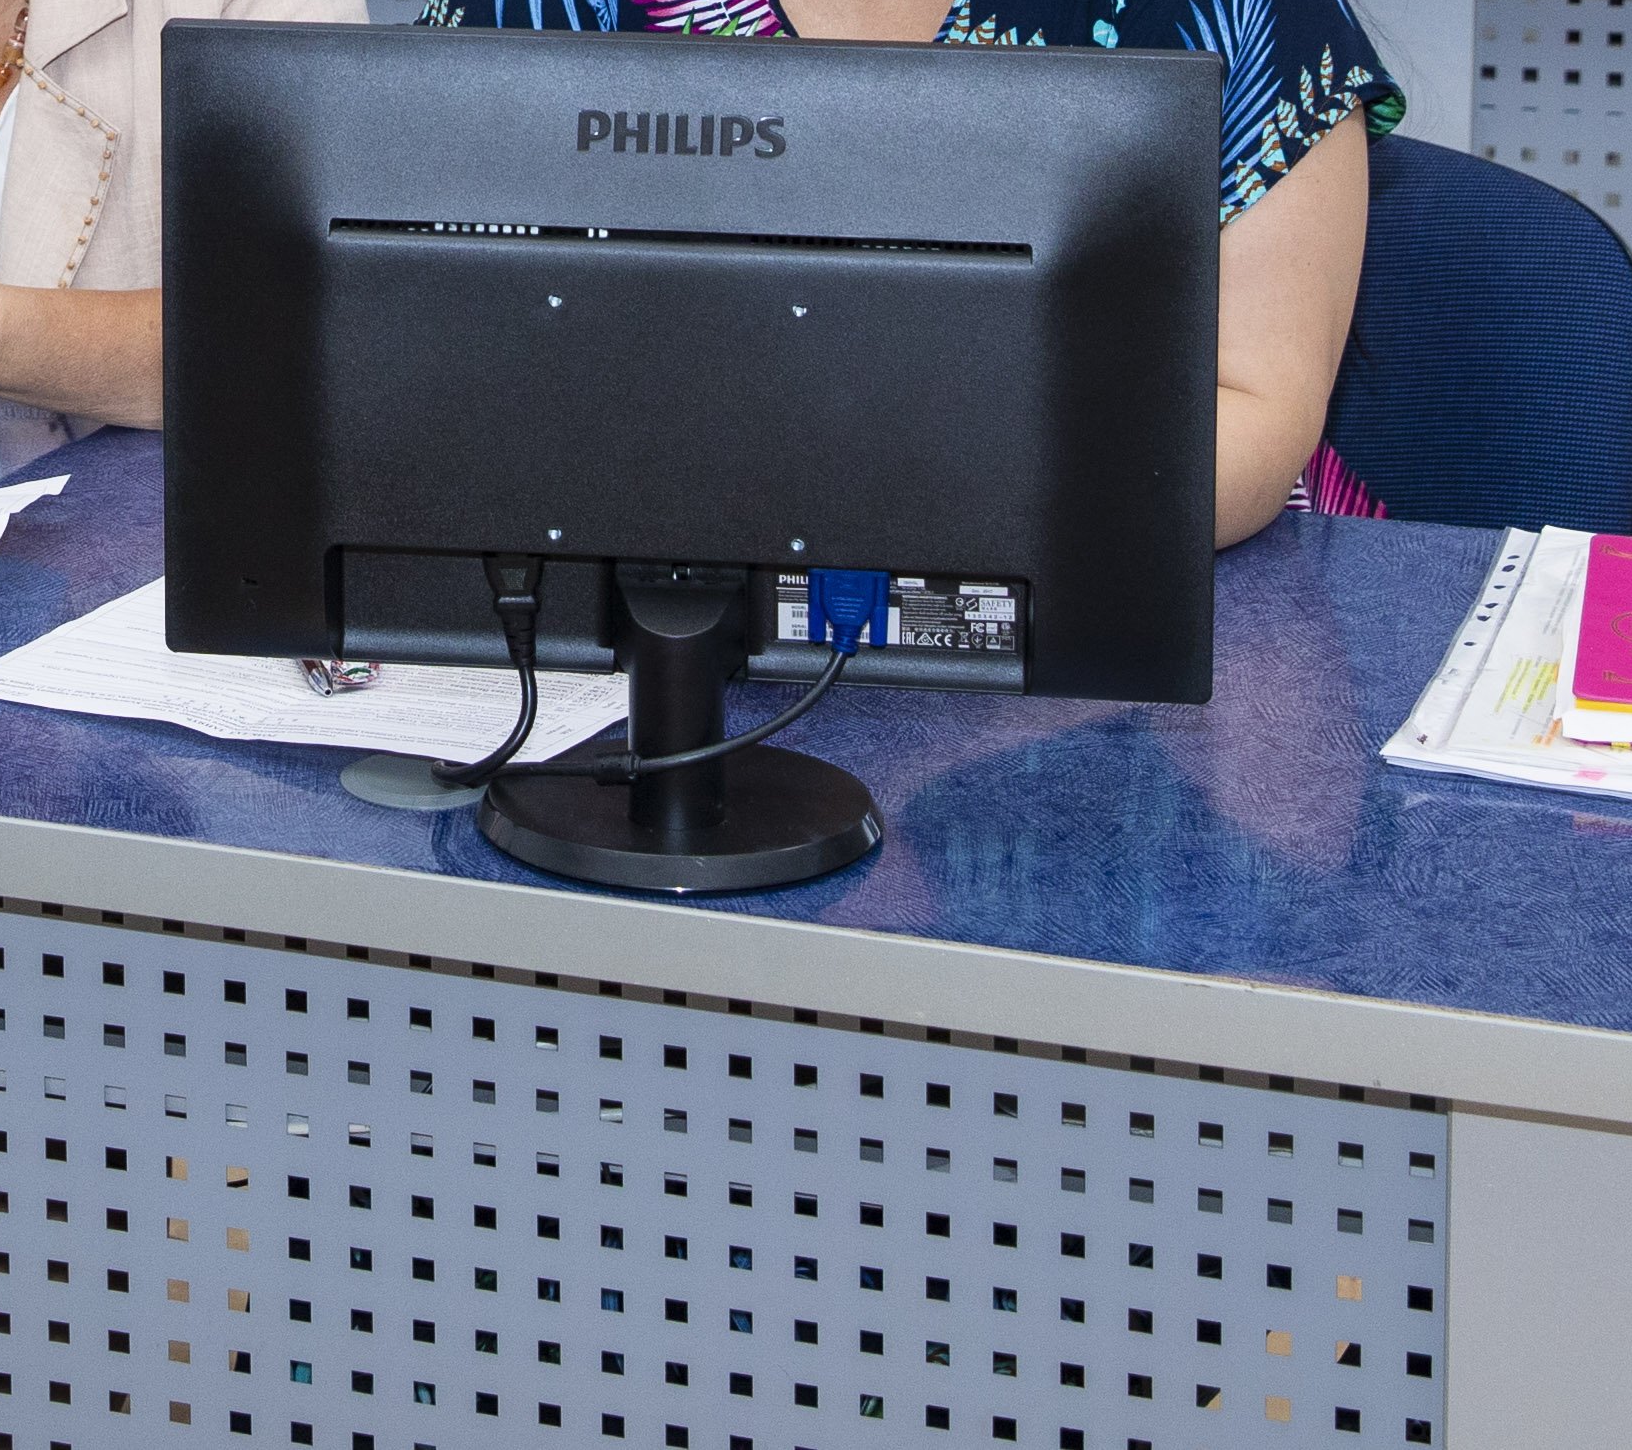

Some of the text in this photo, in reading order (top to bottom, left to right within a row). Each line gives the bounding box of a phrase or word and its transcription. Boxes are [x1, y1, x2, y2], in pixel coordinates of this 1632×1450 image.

[577, 109, 787, 158] PHILIPS
[778, 574, 809, 585] PHILI
[981, 599, 1013, 608] SAFETY
